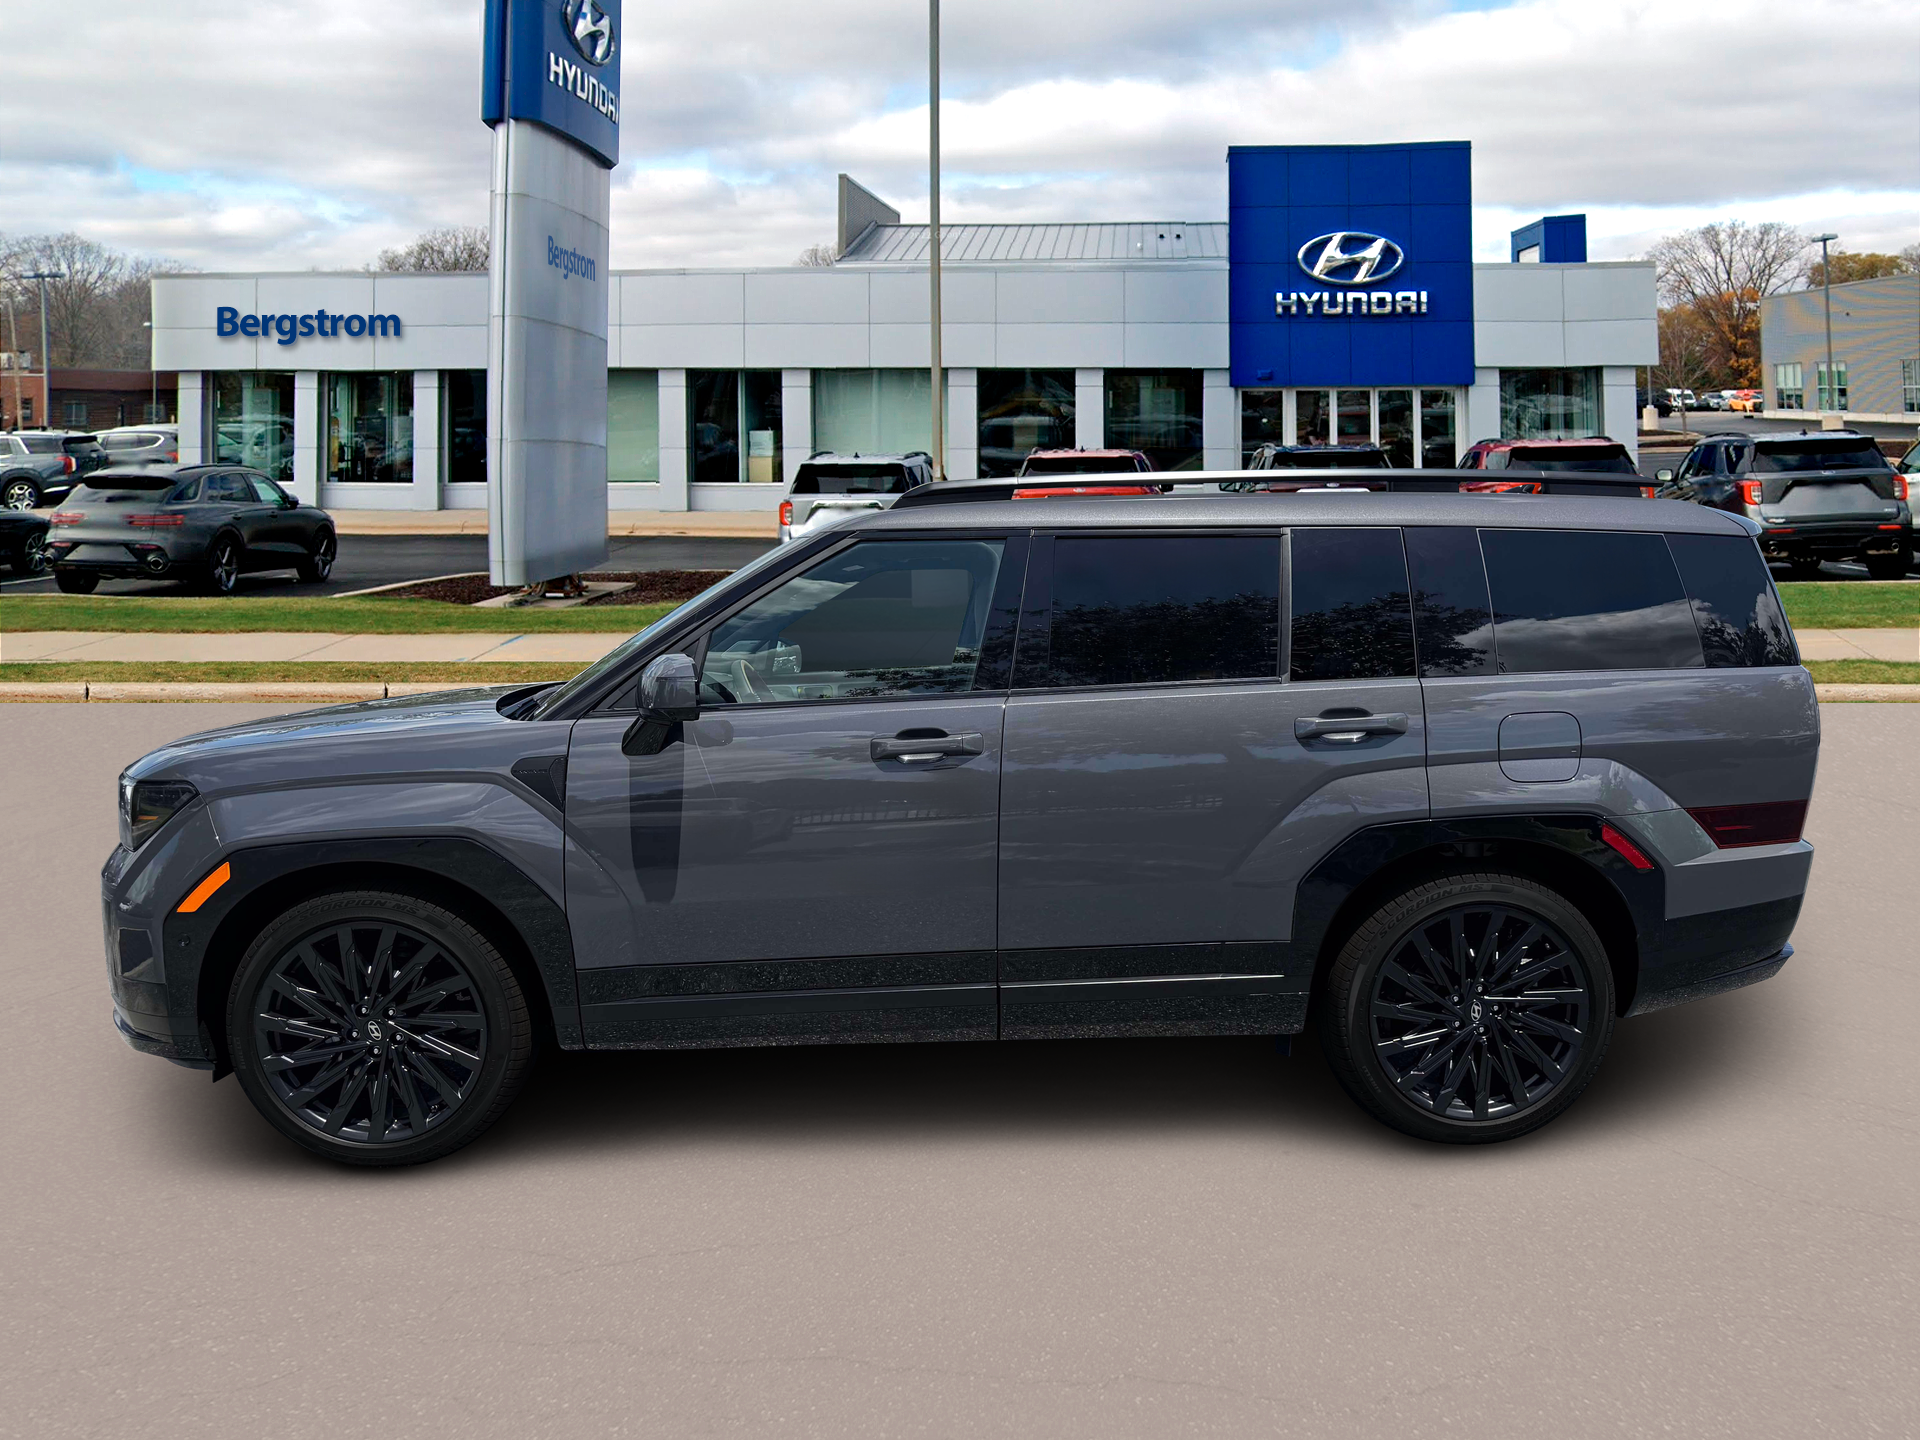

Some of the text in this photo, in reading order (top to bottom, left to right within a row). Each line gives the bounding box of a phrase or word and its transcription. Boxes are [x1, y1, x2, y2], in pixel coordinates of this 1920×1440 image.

[548, 52, 619, 124] HYUNDAI
[547, 235, 596, 282] Bergstrom
[1275, 291, 1428, 315] HYUNDAI
[216, 306, 402, 346] Bergstrom
[298, 899, 388, 920] SCORPION
[1379, 887, 1454, 939] SCORPION
